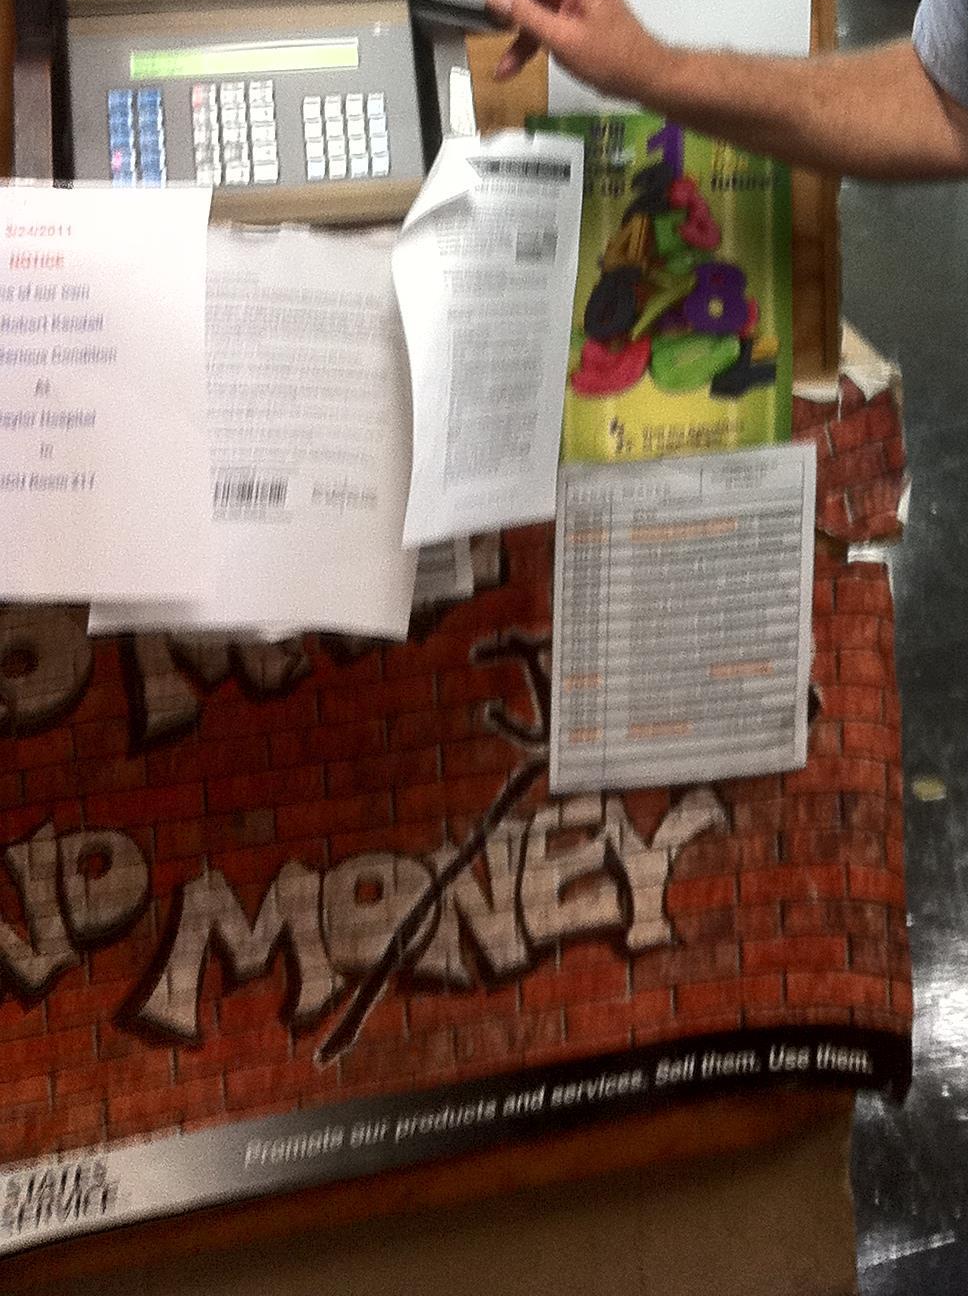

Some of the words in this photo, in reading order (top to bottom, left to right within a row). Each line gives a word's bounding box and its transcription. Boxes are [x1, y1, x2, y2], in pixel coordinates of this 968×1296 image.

[136, 790, 727, 1040] MONEY
[245, 1126, 345, 1168] Promote
[350, 1120, 388, 1148] our
[395, 1100, 498, 1144] products
[501, 1082, 547, 1117] and
[654, 1053, 697, 1087] Sell
[702, 1048, 761, 1079] them.
[768, 1042, 811, 1074] Use
